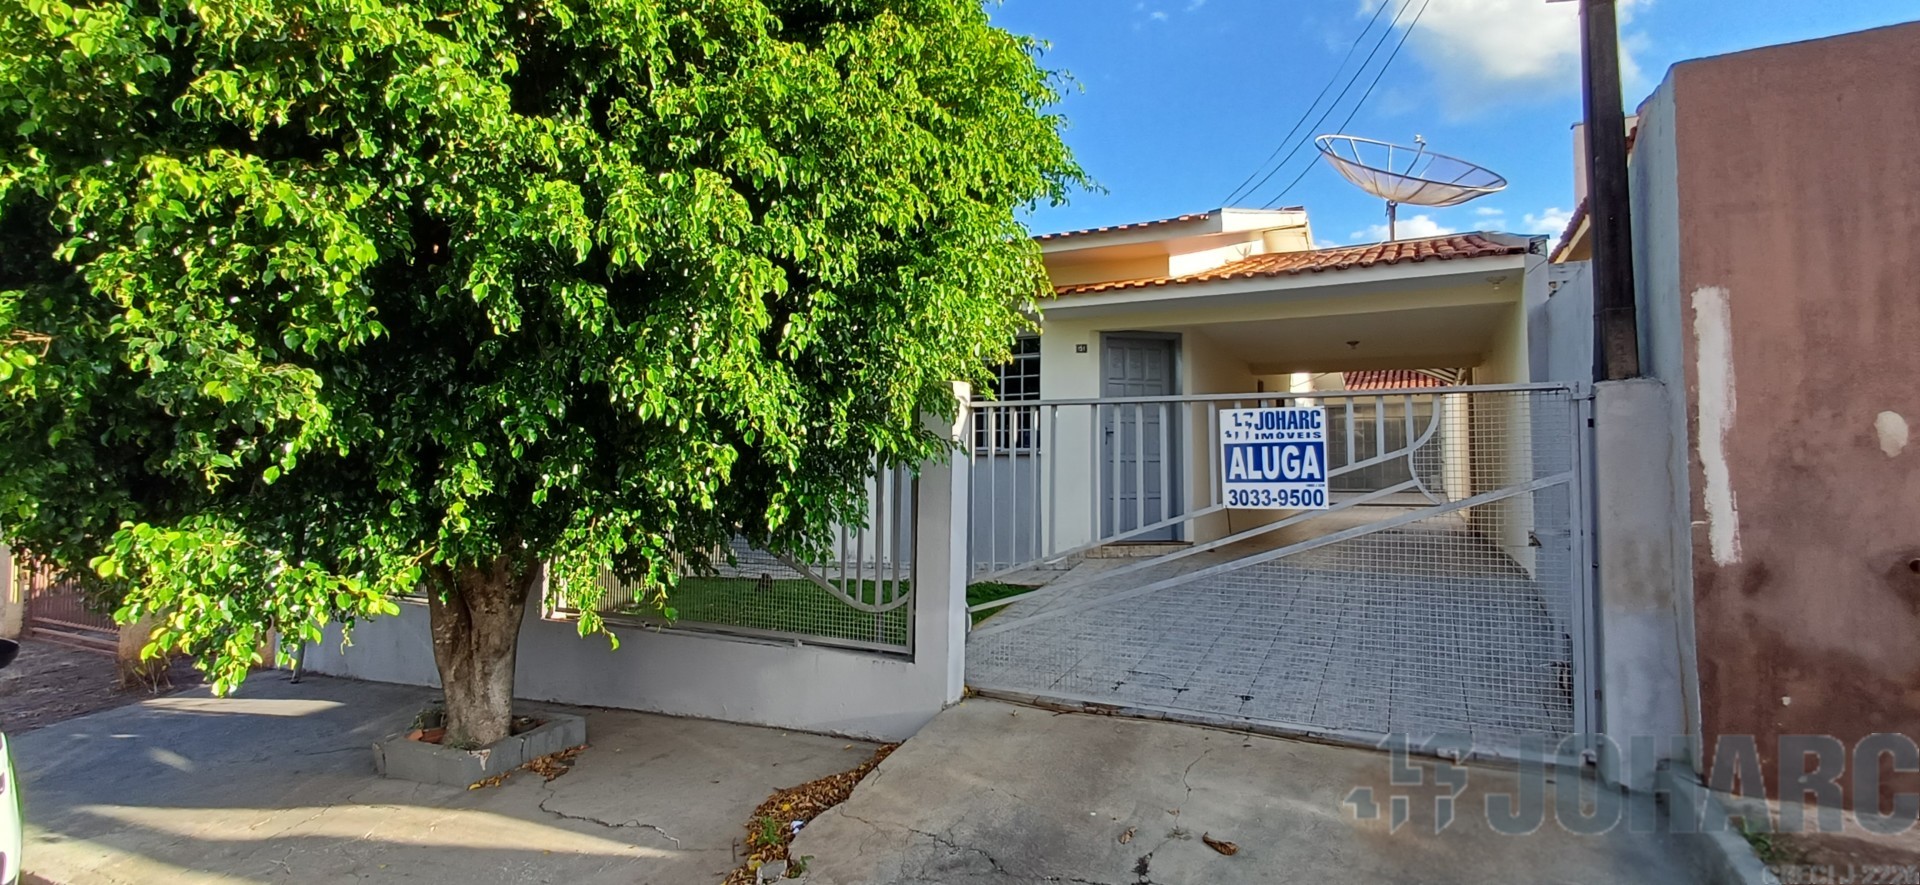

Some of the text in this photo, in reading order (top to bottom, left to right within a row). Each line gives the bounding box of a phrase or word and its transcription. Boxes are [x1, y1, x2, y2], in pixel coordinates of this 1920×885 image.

[1254, 410, 1321, 430] JOHARC
[1255, 431, 1322, 440] IMÓVEIS
[1228, 445, 1321, 480] ALUGA
[1228, 489, 1324, 507] 3033-9500
